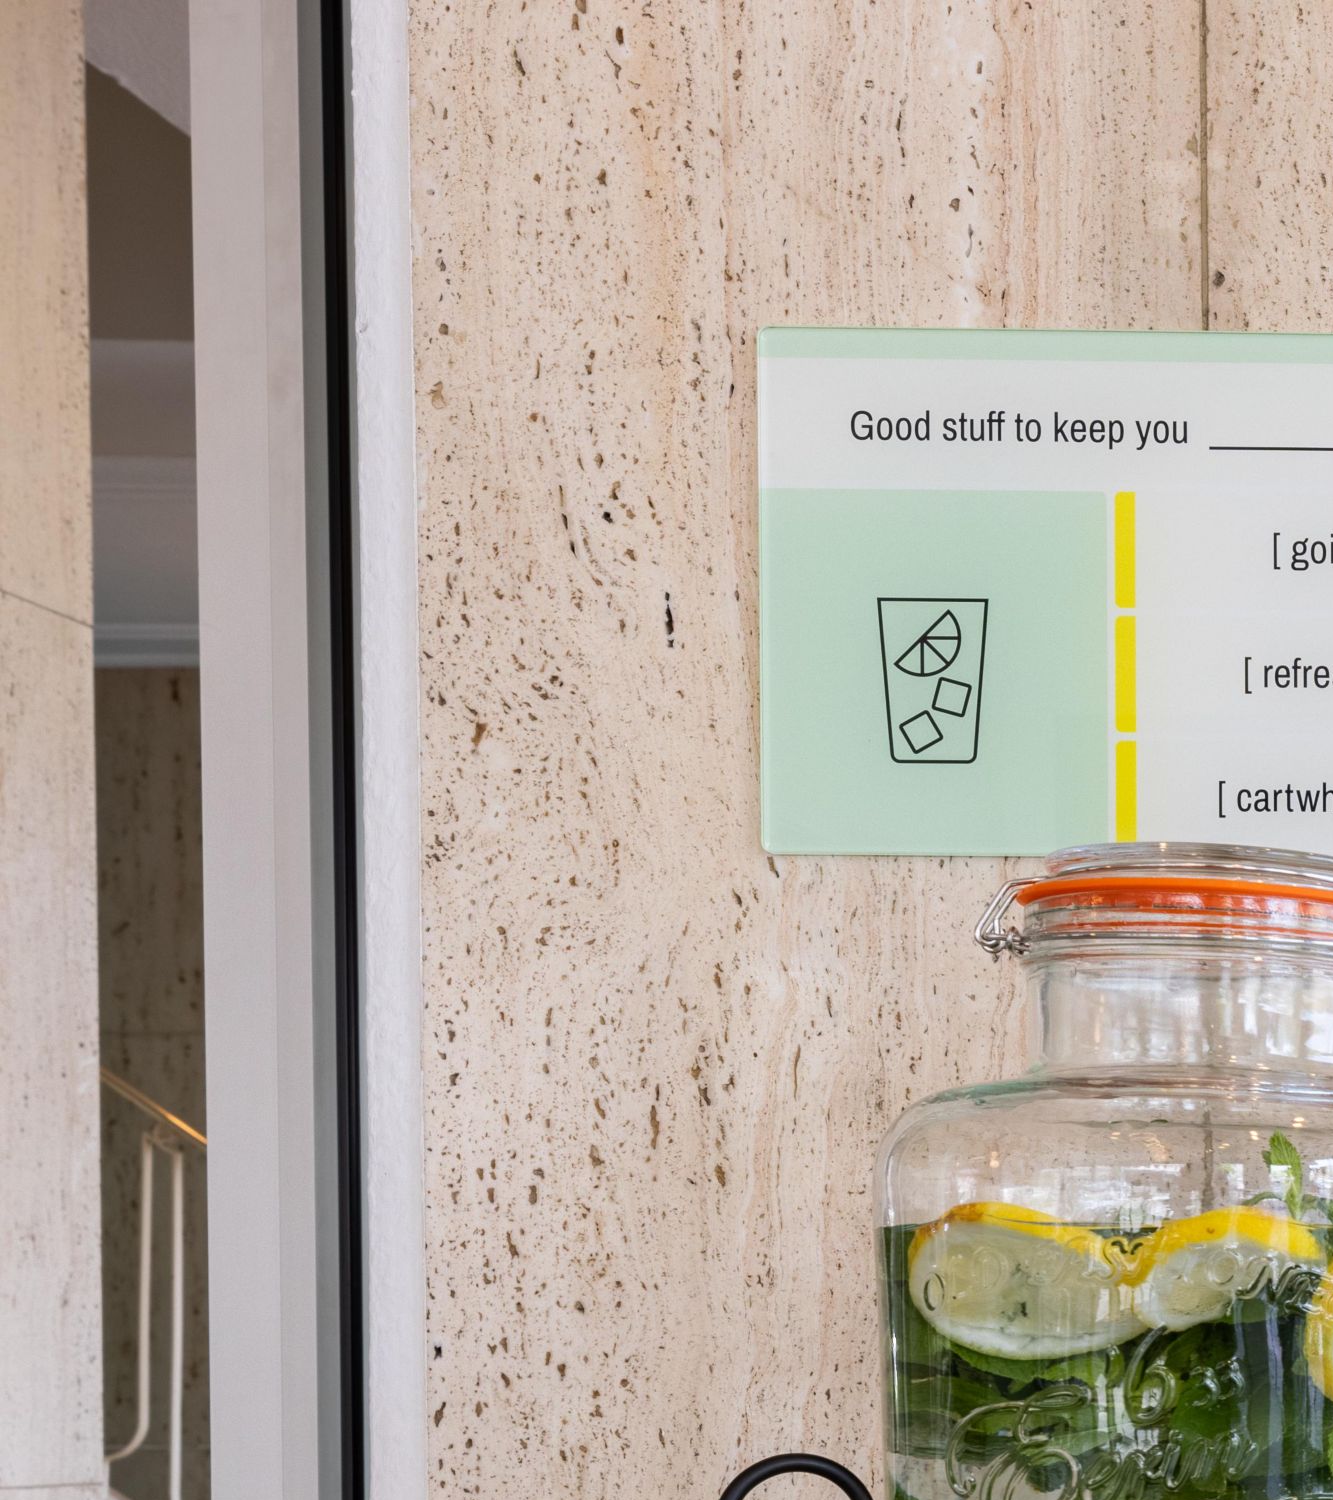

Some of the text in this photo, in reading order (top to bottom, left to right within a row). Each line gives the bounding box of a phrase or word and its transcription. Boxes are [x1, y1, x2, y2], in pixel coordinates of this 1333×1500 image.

[851, 410, 929, 441] Good
[943, 411, 1005, 441] stuff
[1015, 414, 1041, 442] to
[1054, 412, 1124, 449] keep
[1136, 421, 1187, 450] you
